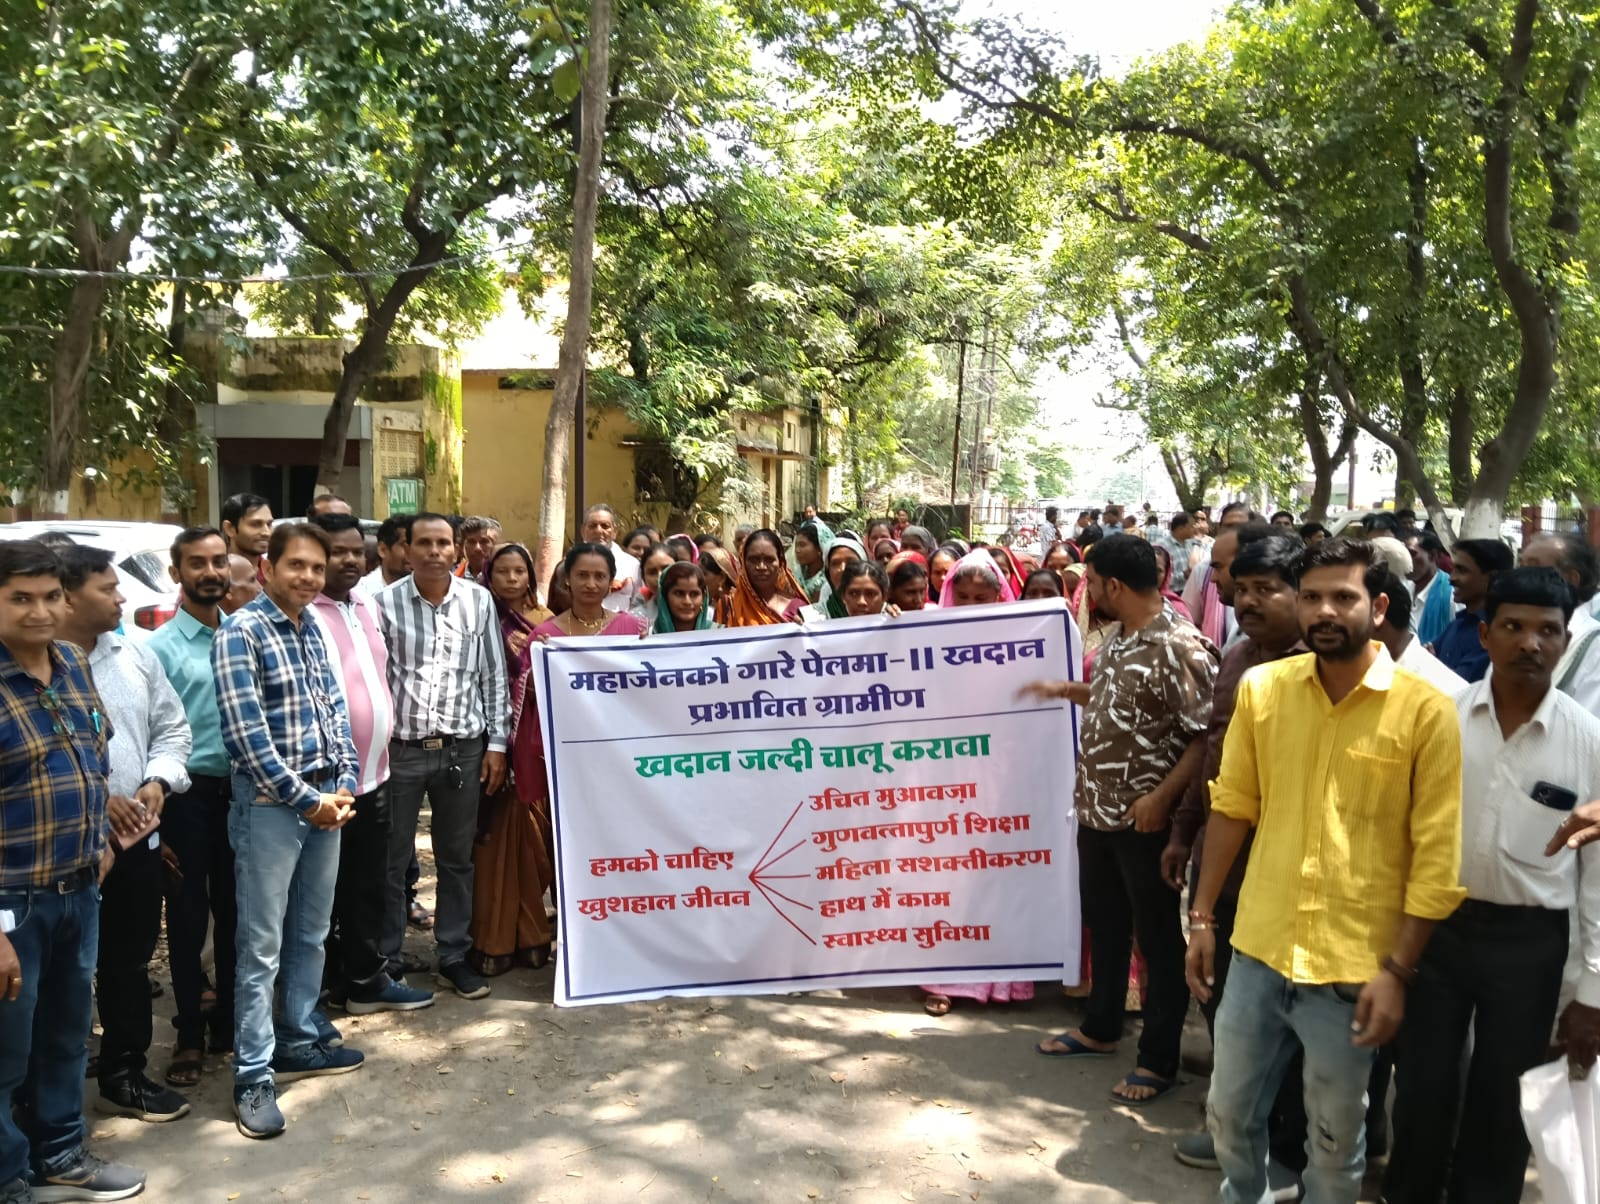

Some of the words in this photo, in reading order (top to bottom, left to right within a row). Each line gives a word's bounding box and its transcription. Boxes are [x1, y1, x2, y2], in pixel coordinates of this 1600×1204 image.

[390, 482, 415, 504] ATM
[568, 656, 730, 693] महाजेनको
[736, 650, 796, 680] गारे
[941, 638, 1046, 665] खदान
[688, 690, 807, 725] प्रभावित
[813, 683, 926, 718] ग्रामीण
[634, 751, 731, 778] खदान
[737, 738, 814, 773] जल्दी
[819, 741, 895, 773] चालू
[891, 734, 991, 761] करावा
[809, 788, 870, 811] उचित
[963, 812, 1030, 834] शिक्षा
[589, 849, 659, 877] हमको
[664, 846, 734, 870] चाहिए
[815, 857, 891, 880] महिला
[896, 848, 1051, 872] सशक्तीकरण
[576, 894, 676, 921] खुशहाल
[681, 886, 751, 908] जीवन
[819, 896, 866, 917] हाथ
[871, 887, 892, 908] में
[896, 892, 950, 907] काम
[822, 928, 907, 948] स्वास्थ्य
[912, 920, 990, 949] सुविधा
